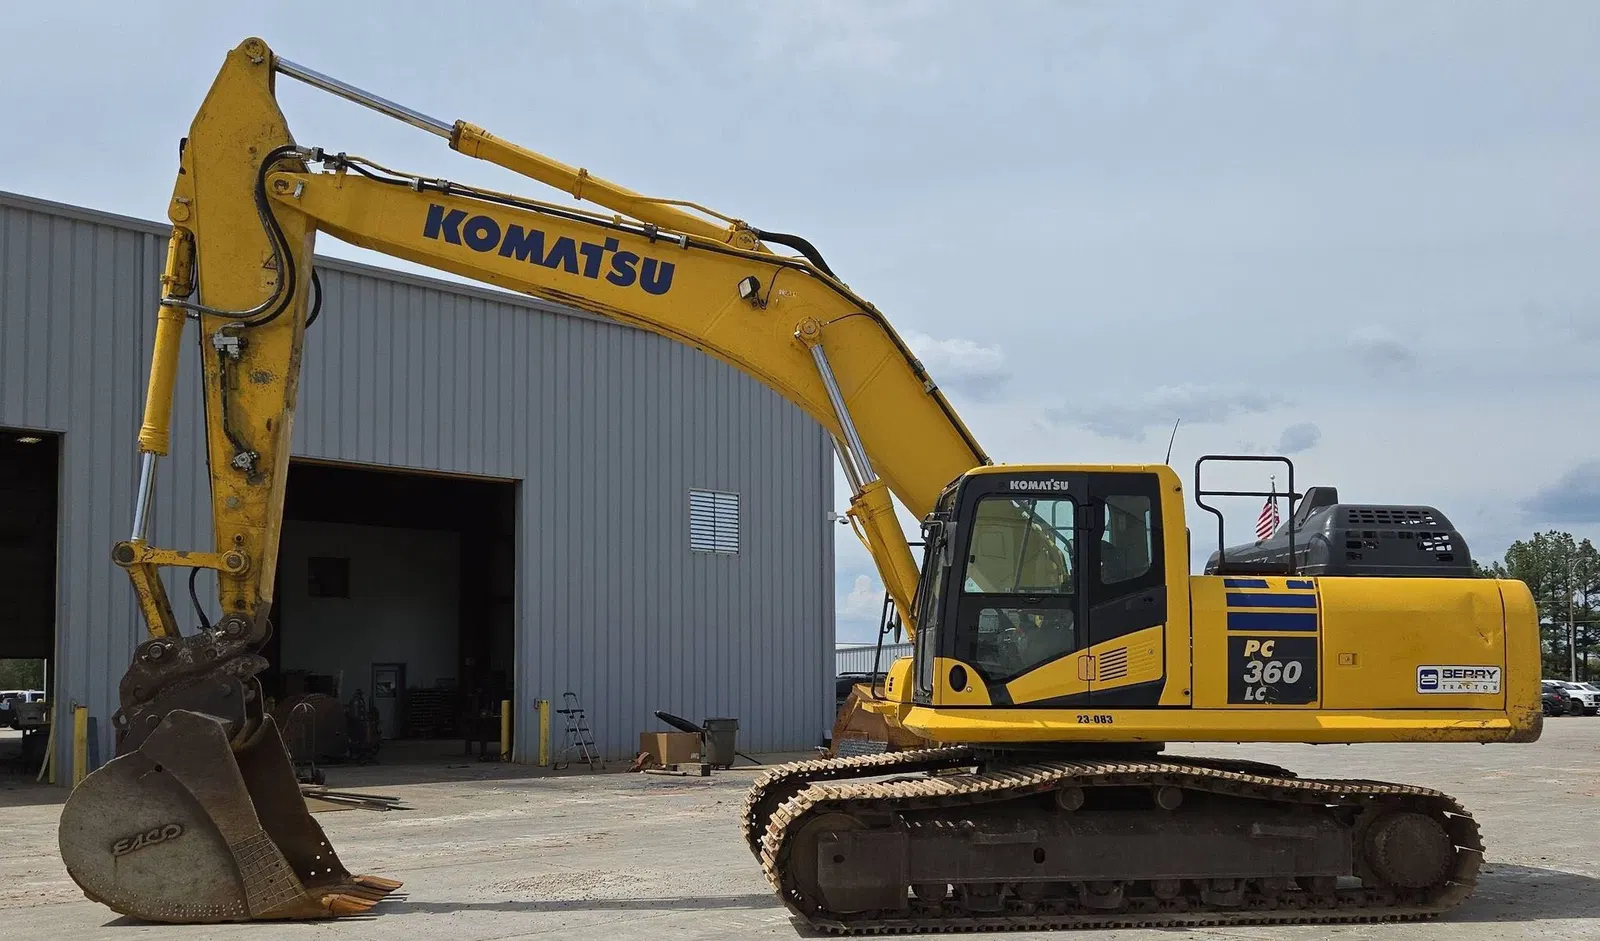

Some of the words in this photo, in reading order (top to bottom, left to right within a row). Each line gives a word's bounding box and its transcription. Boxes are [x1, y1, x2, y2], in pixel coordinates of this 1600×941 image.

[423, 203, 676, 296] KOMATSU
[1010, 479, 1069, 490] KOMATSU
[1243, 640, 1275, 657] PC
[1243, 661, 1303, 684] 360
[1442, 669, 1498, 679] BERRY
[1244, 686, 1267, 701] LC
[1077, 715, 1113, 724] 23-083
